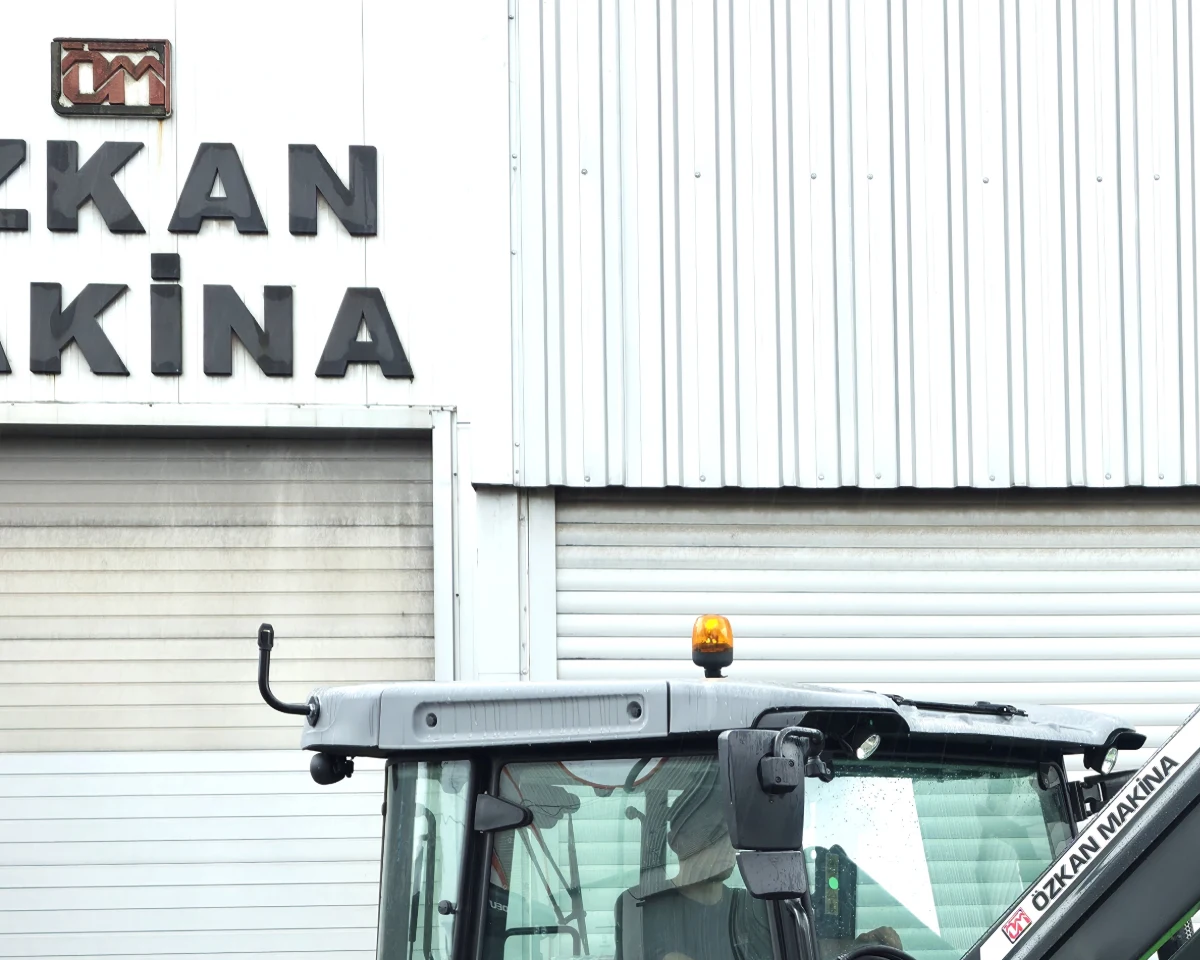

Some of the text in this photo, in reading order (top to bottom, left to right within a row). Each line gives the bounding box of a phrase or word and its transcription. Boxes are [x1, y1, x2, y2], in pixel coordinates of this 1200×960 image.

[0, 253, 414, 379] KİNA
[1031, 836, 1100, 912] ÖZKAN
[1097, 755, 1180, 842] MAKİNA
